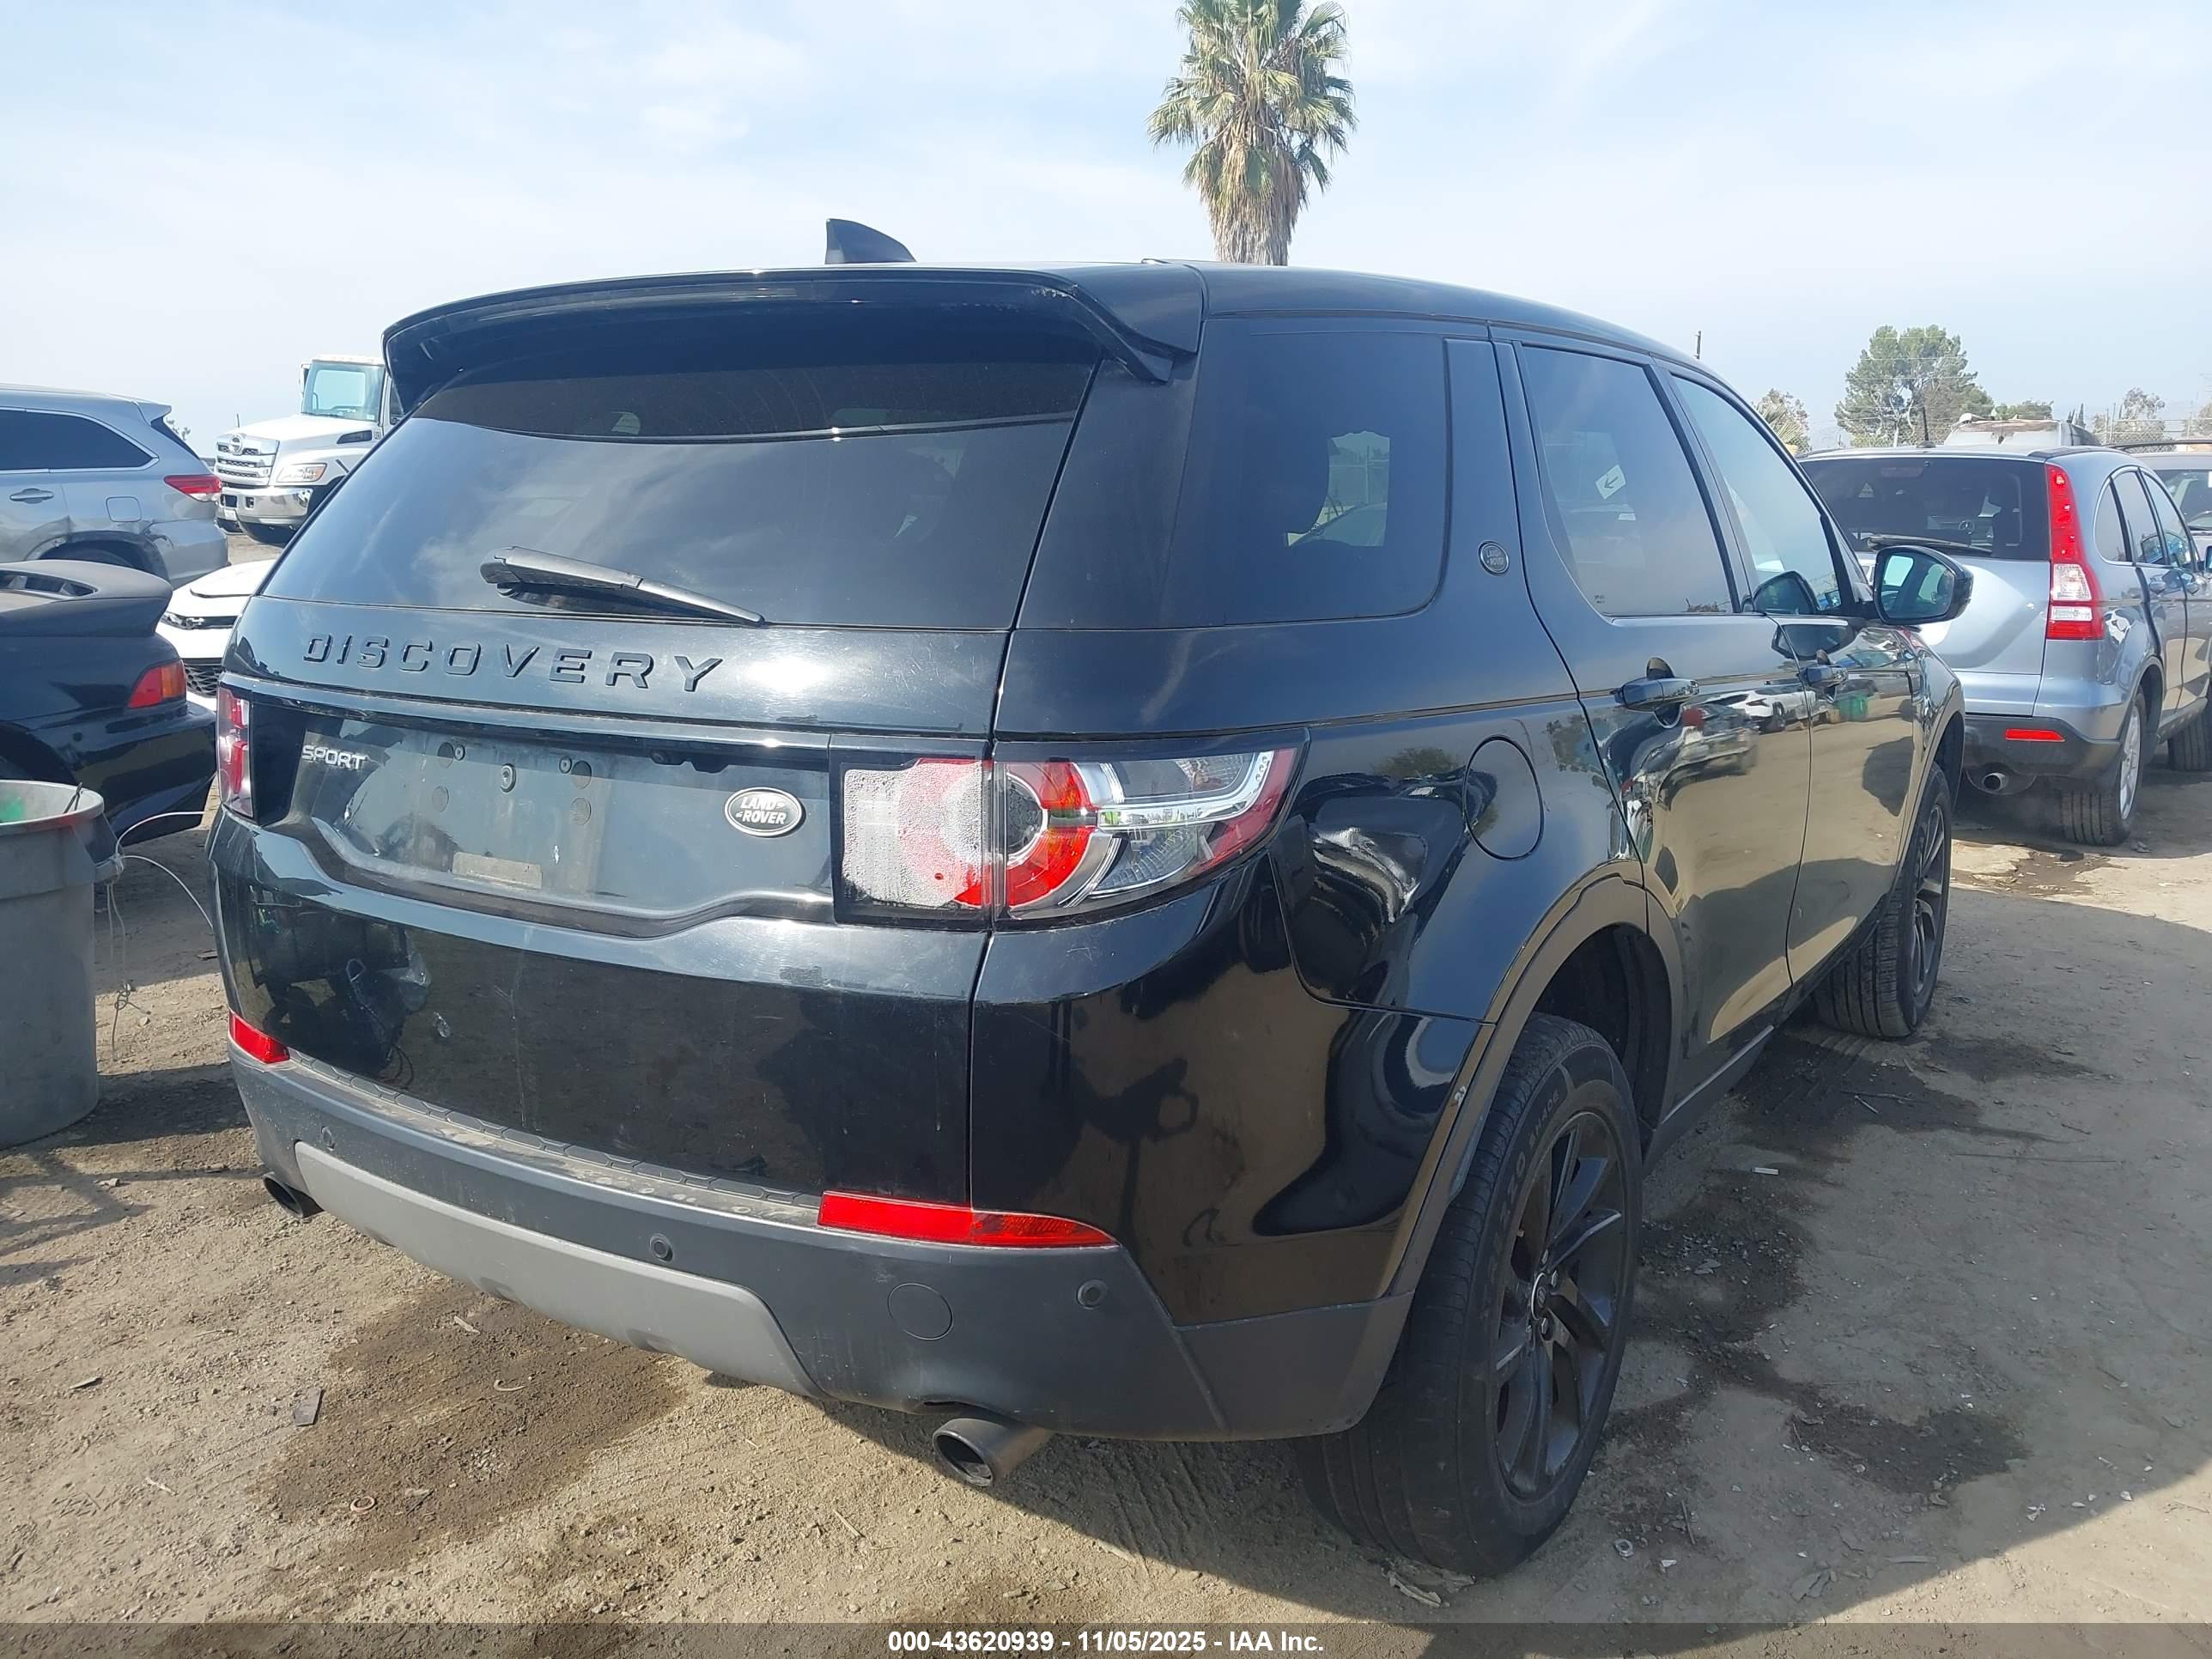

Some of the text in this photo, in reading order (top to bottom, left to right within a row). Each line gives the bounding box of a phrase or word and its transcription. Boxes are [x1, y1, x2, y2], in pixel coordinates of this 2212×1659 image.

[303, 633, 723, 692] DISCOVERY
[301, 744, 366, 770] SPORT
[741, 796, 777, 811] LAND
[742, 810, 787, 824] ROVER
